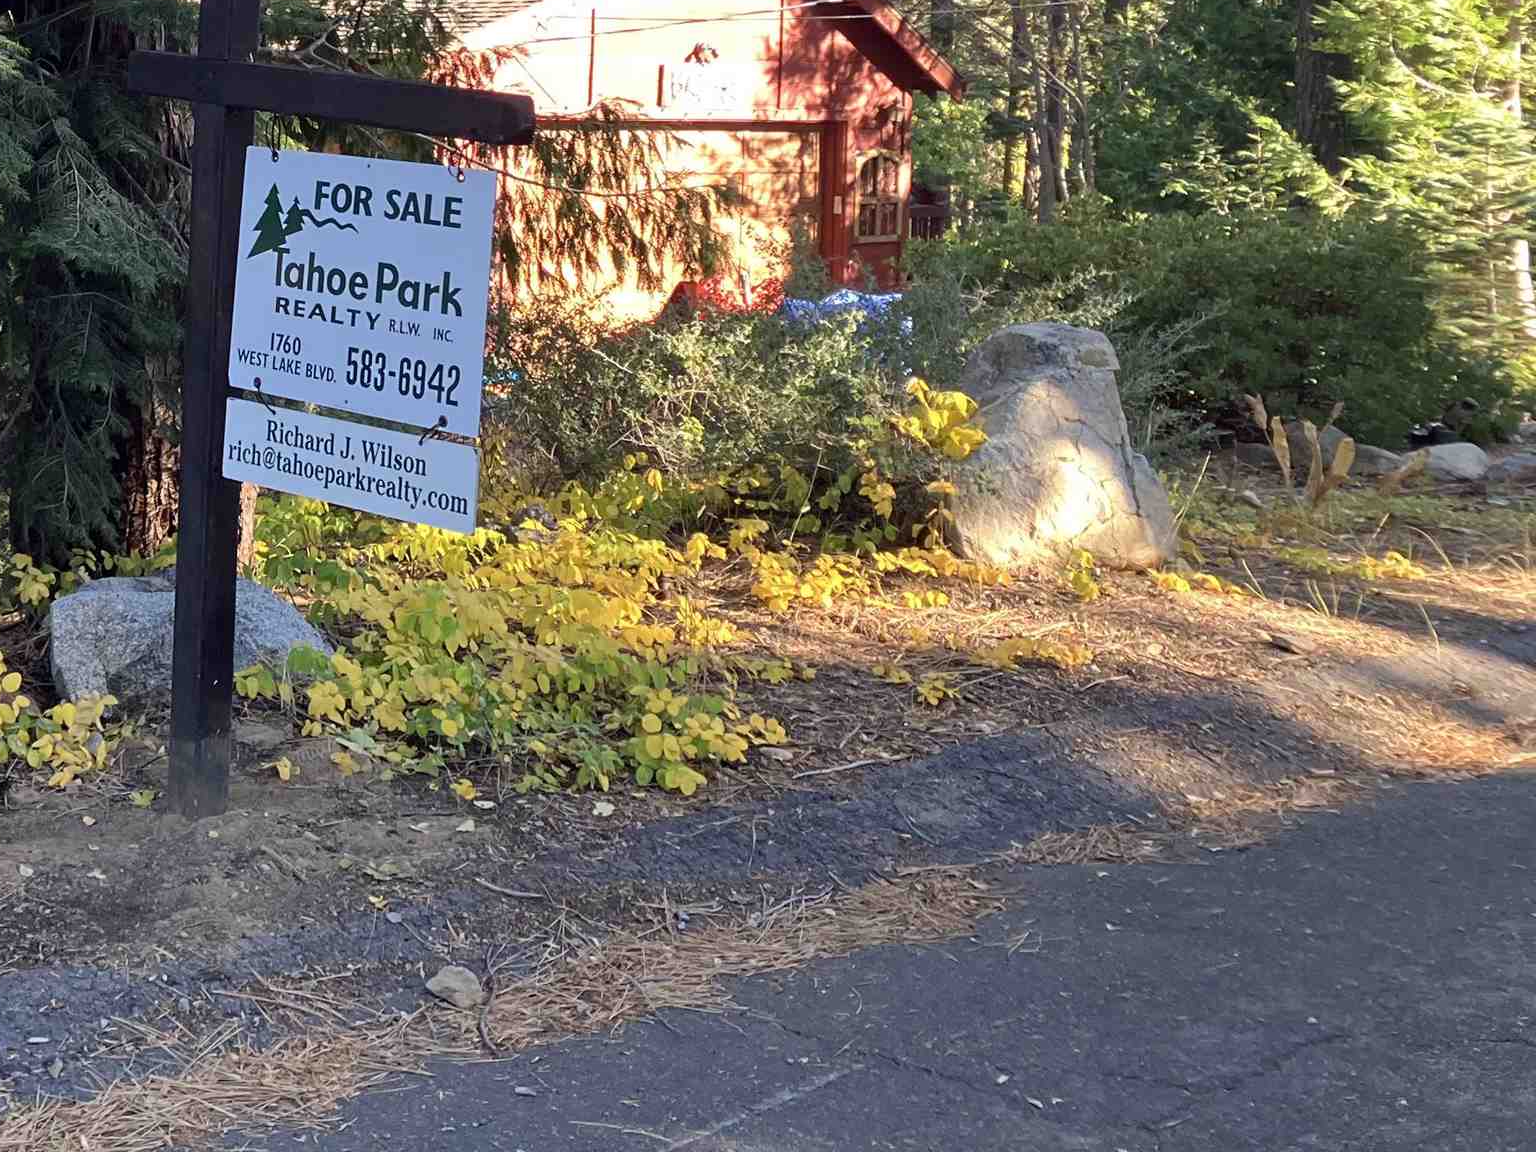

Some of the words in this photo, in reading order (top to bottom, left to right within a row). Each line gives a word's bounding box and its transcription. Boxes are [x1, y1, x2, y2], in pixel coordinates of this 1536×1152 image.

[314, 180, 373, 217] FOR
[384, 189, 463, 229] SALE
[272, 247, 369, 300] Tahoe
[375, 262, 463, 317] Park
[275, 297, 380, 330] REALTY
[388, 319, 421, 337] R.L.W.
[237, 348, 269, 368] WEST
[272, 355, 301, 376] LAKE
[305, 362, 337, 384] BLVD.
[270, 332, 302, 356] 1760
[345, 346, 461, 407] 583-6942
[266, 419, 335, 456] Richard
[339, 436, 355, 461] J.
[362, 439, 427, 477] Wilson
[227, 440, 469, 516] rich@tahoeparkrealty.com
